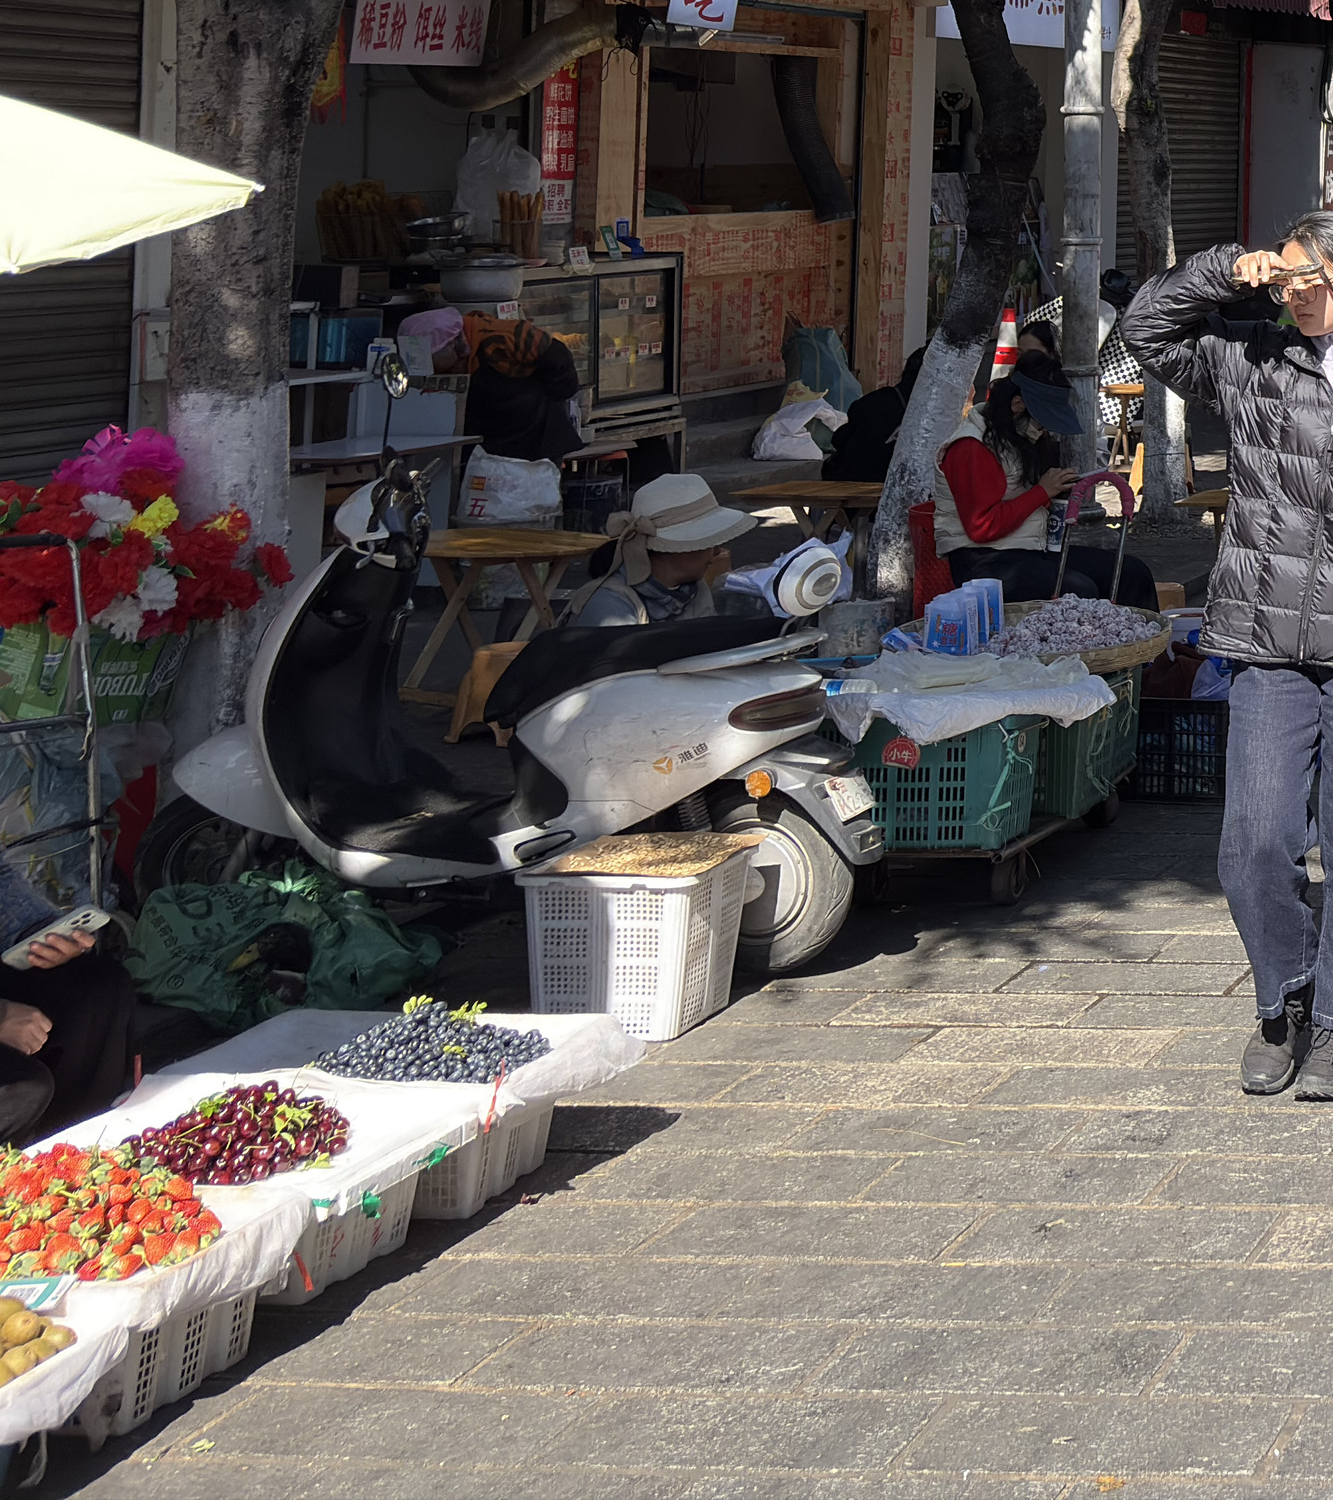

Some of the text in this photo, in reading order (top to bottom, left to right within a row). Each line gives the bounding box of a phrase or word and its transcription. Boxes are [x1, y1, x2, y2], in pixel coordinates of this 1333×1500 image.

[357, 0, 485, 54] 稀豆粉 饵丝 米线
[677, 742, 709, 764] 雅迪
